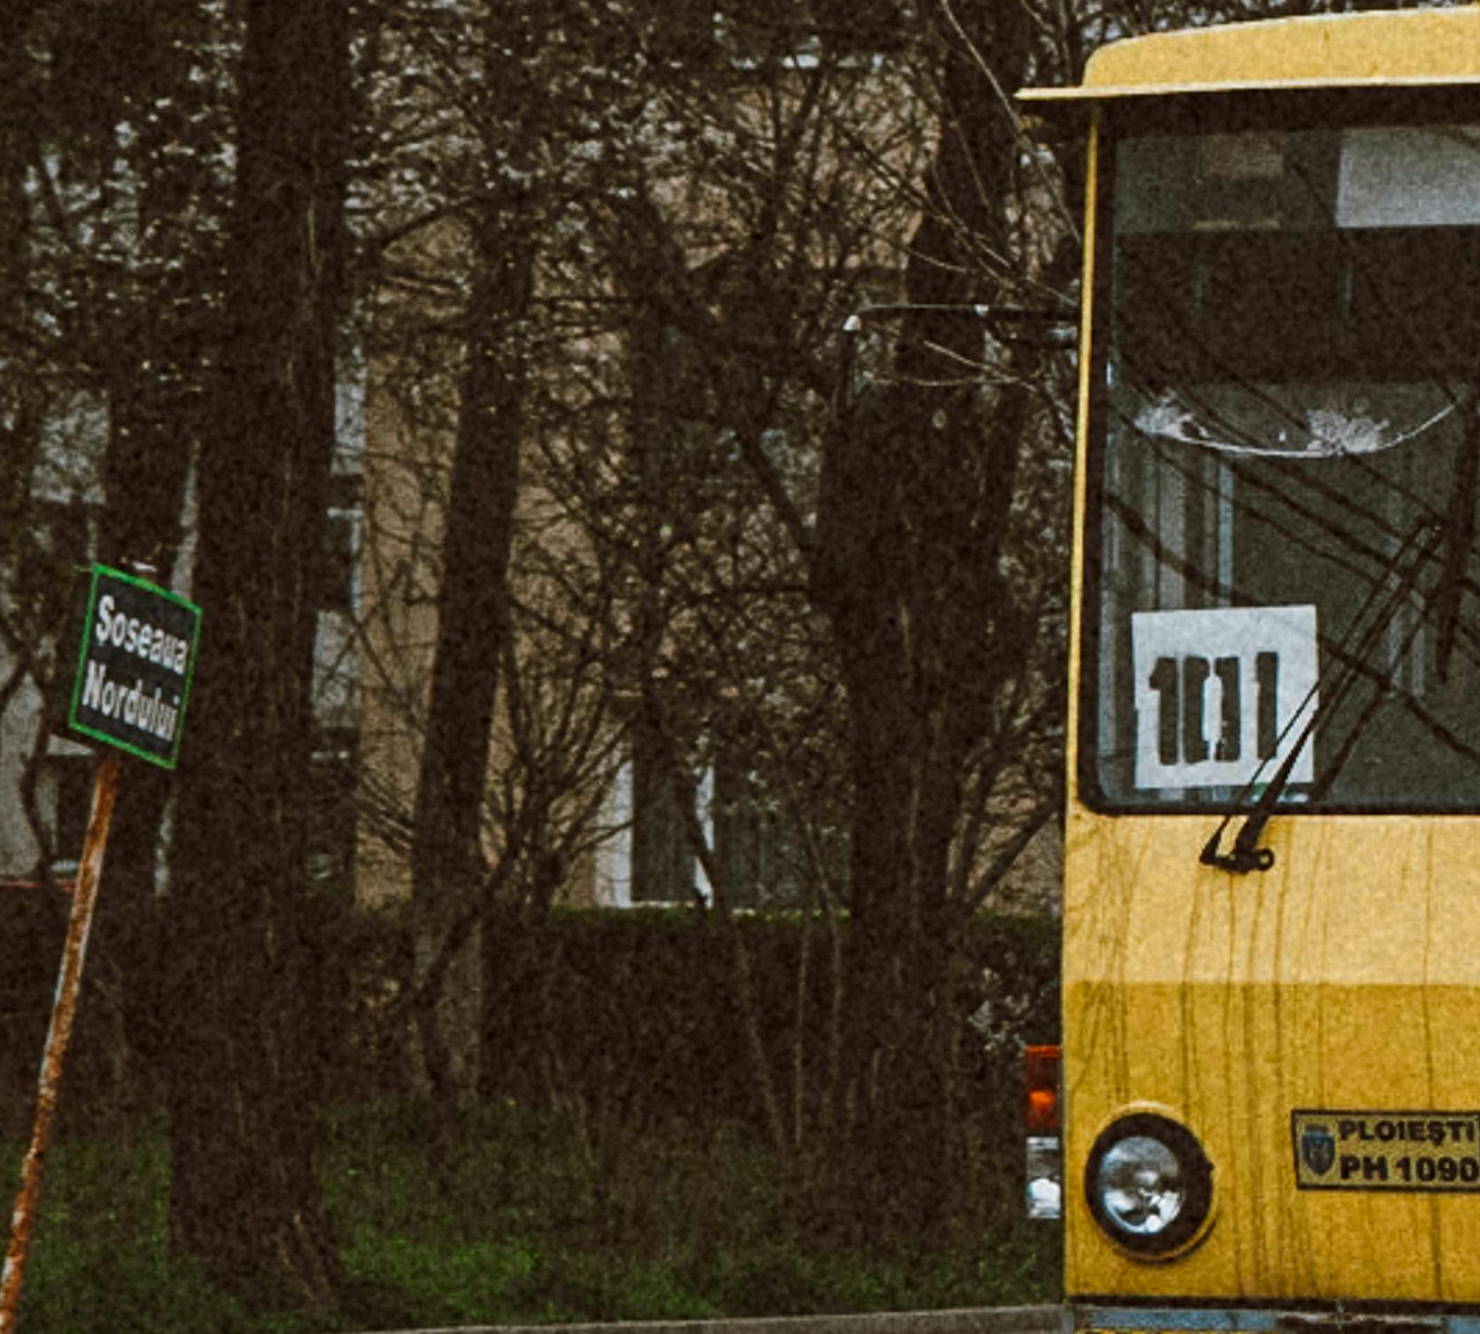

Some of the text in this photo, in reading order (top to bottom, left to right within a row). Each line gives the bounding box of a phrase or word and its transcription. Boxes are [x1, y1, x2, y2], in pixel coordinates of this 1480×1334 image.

[82, 658, 181, 742] Nordului
[1340, 1154, 1480, 1183] PH 1090
